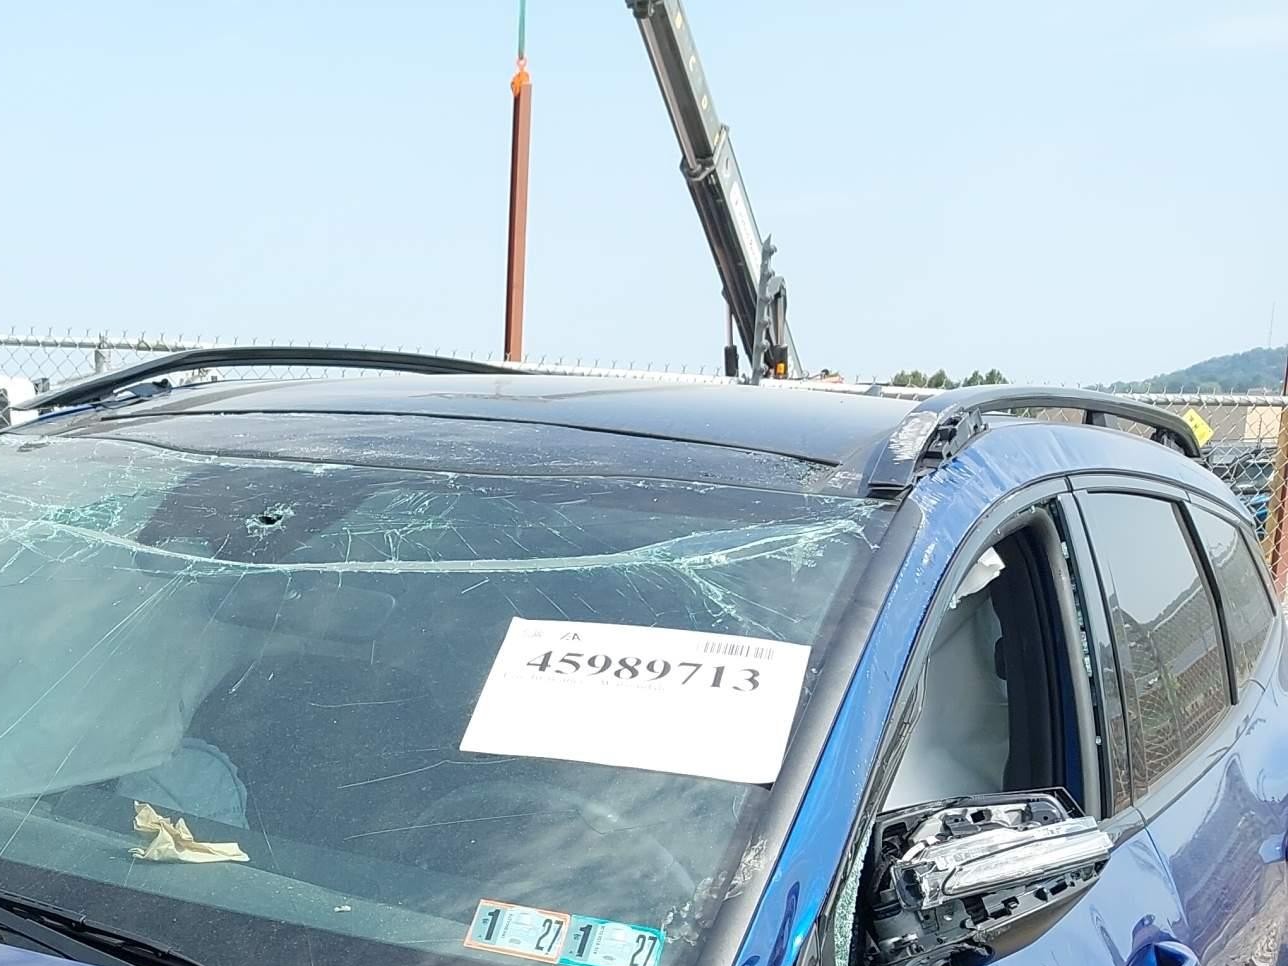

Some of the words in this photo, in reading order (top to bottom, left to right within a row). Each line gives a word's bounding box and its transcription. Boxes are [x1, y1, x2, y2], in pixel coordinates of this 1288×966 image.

[525, 649, 761, 693] 45989713
[484, 908, 502, 941] 1
[534, 917, 564, 954] 27
[575, 923, 593, 958] 1
